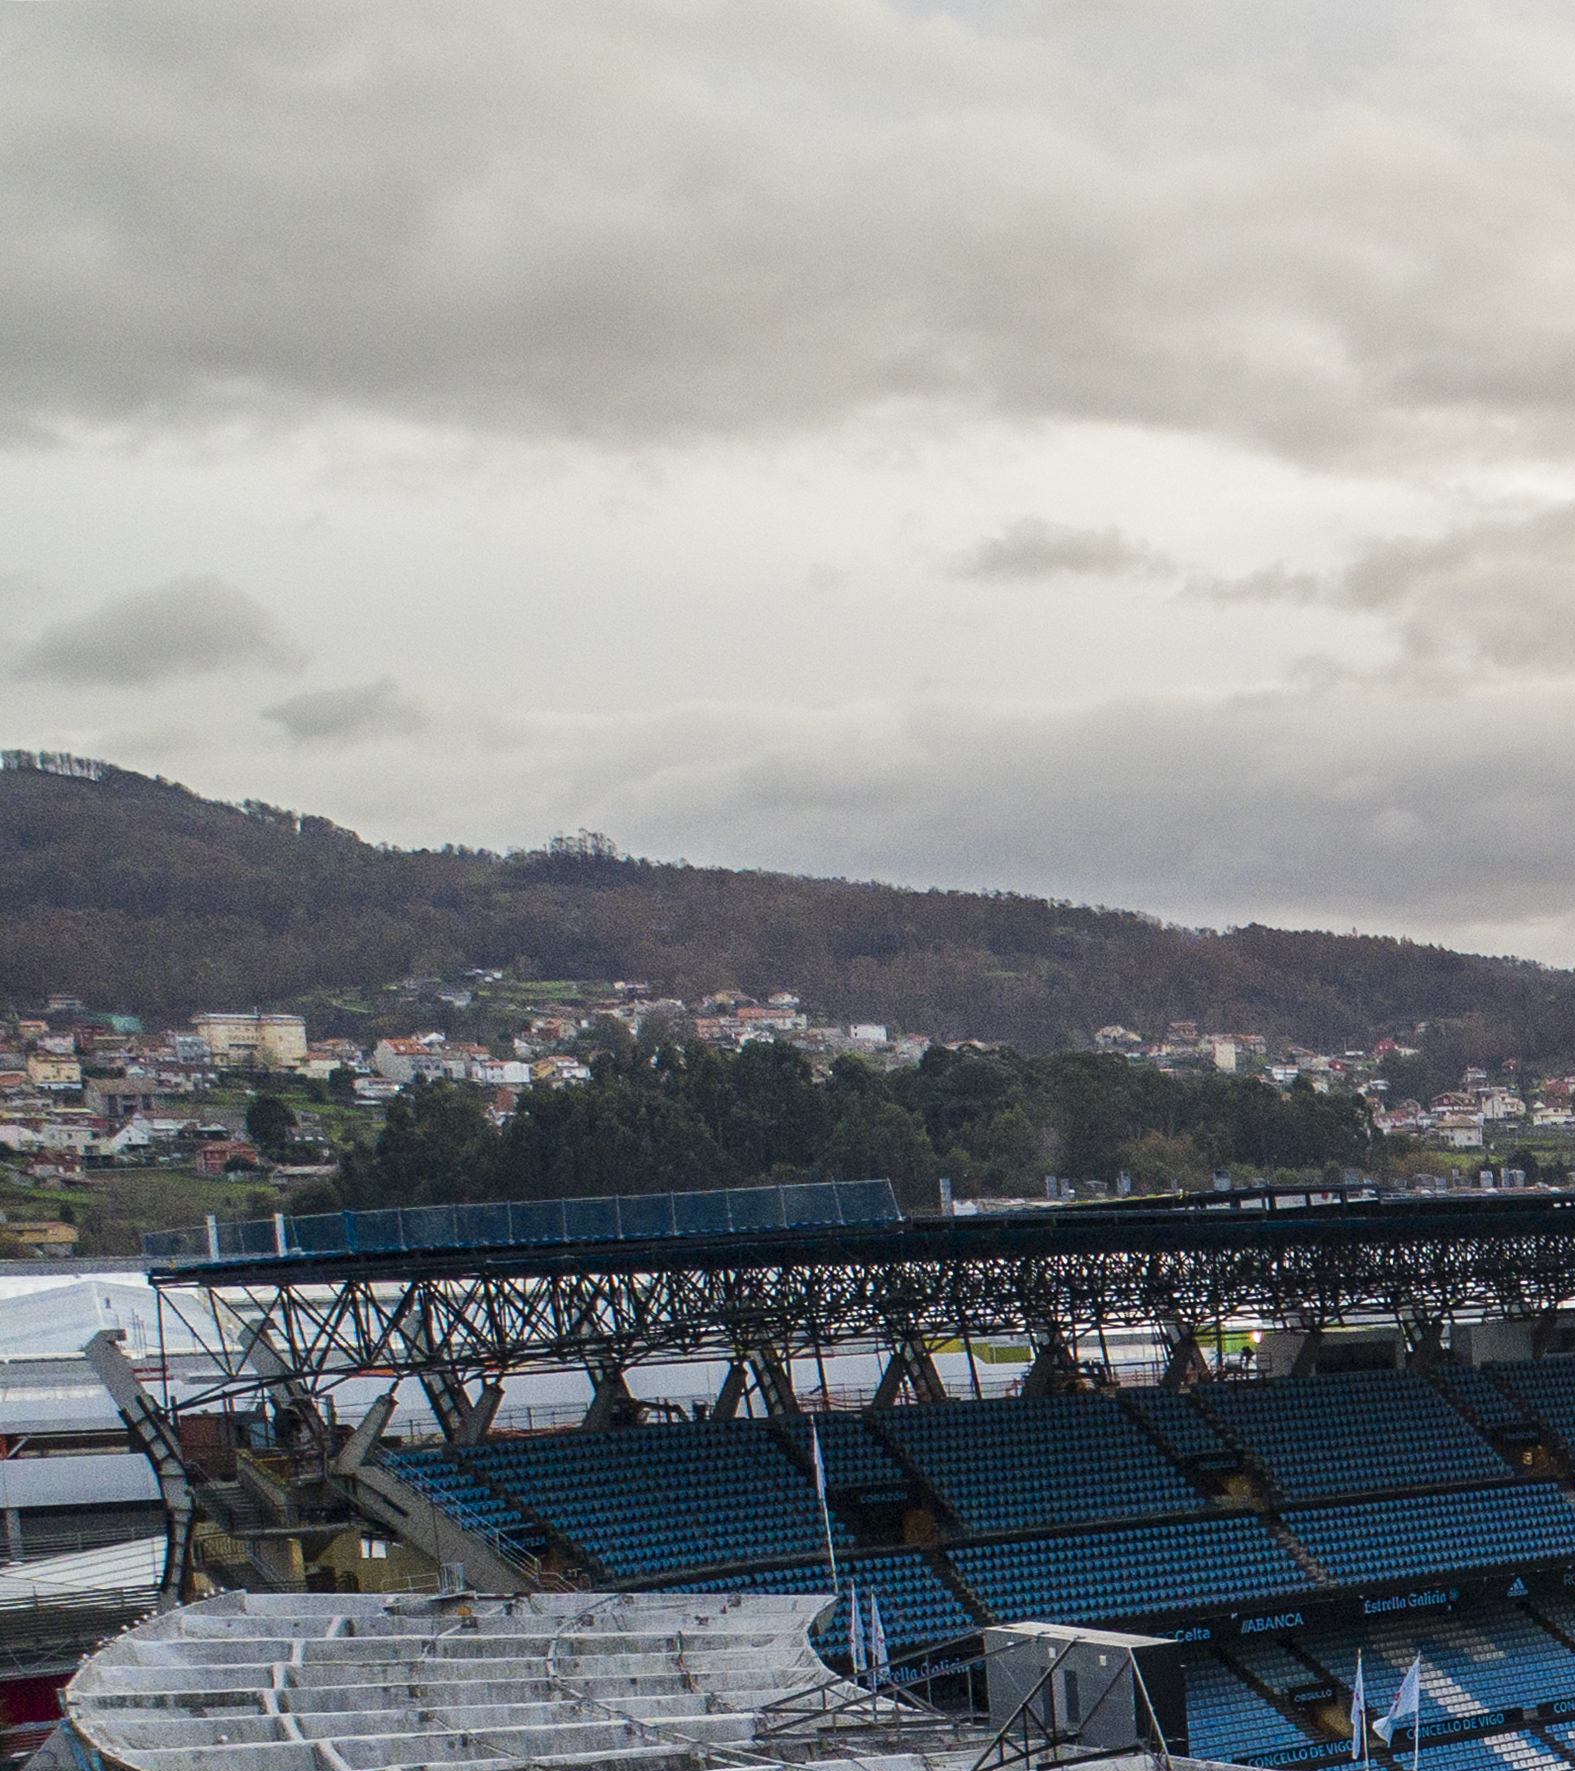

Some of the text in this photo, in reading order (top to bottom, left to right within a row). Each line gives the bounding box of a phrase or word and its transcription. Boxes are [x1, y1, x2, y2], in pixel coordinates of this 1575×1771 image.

[1406, 1712, 1505, 1740] CONCELLO DE VIGO
[1248, 1738, 1355, 1769] CONCELLO DE VIGO
